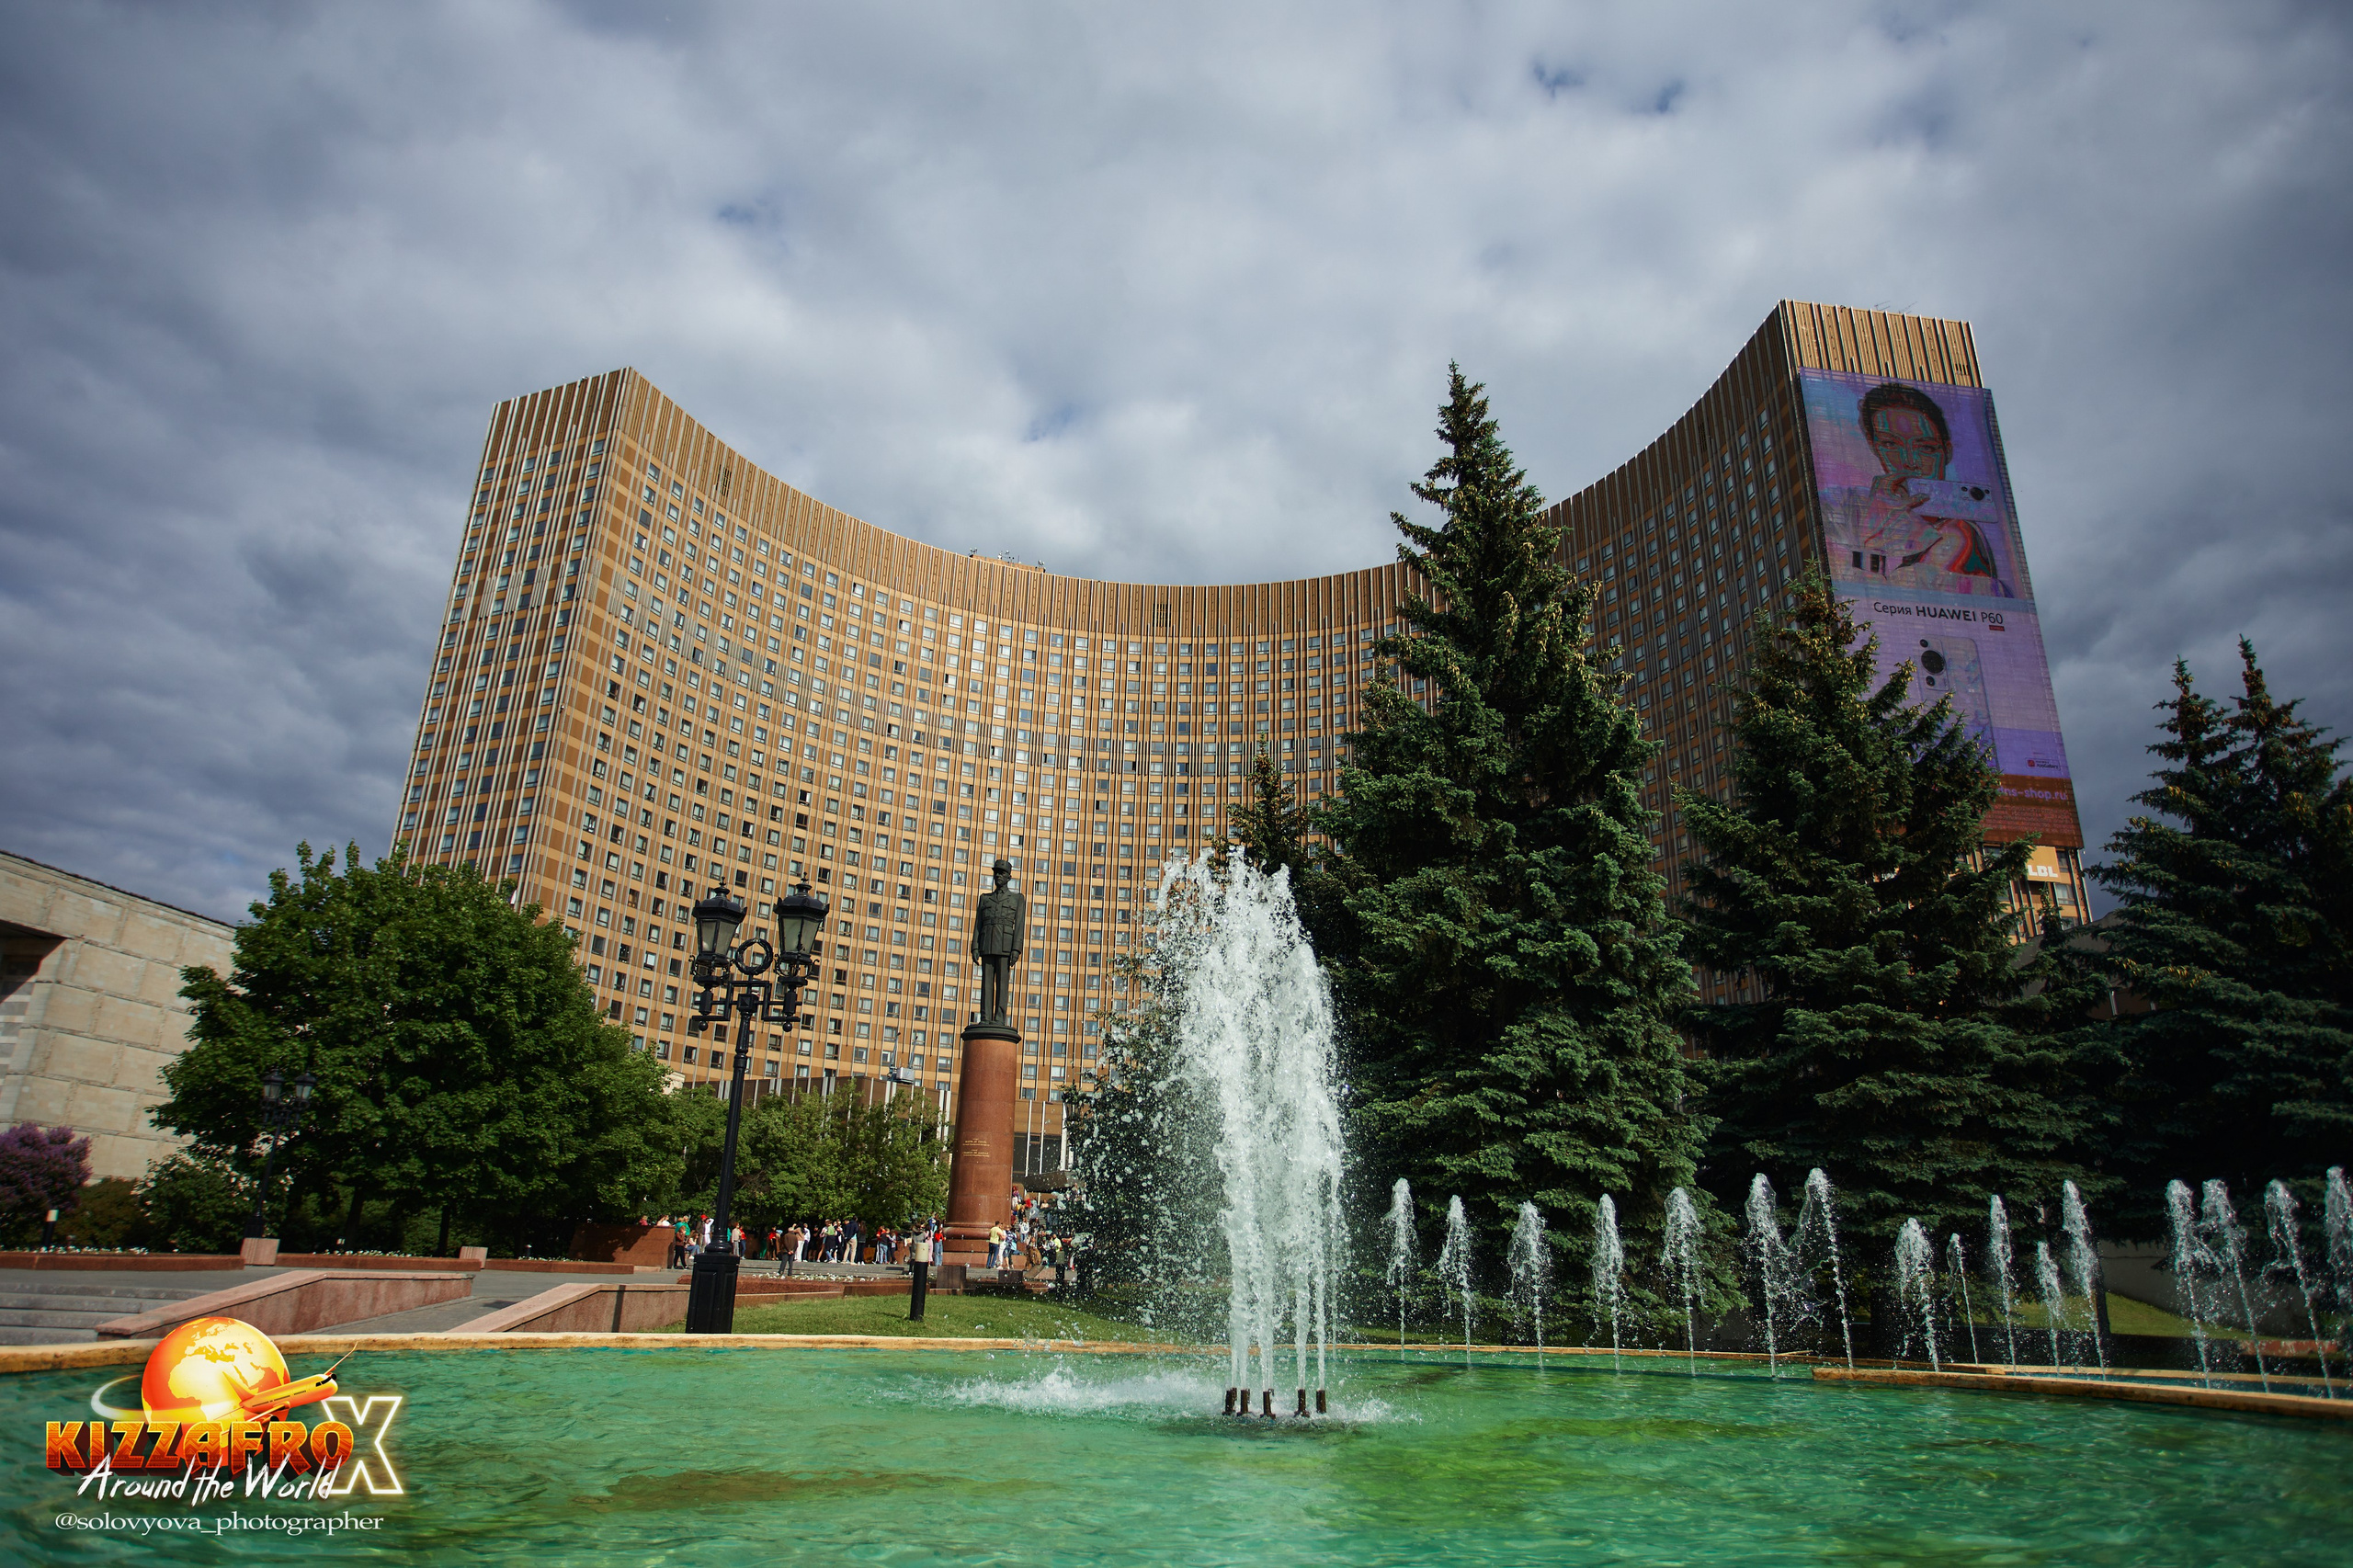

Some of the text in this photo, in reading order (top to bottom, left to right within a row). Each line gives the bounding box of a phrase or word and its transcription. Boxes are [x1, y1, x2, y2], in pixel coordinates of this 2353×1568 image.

[1873, 602, 2004, 624] Серия HUAWEI P60
[2027, 864, 2058, 878] LBL
